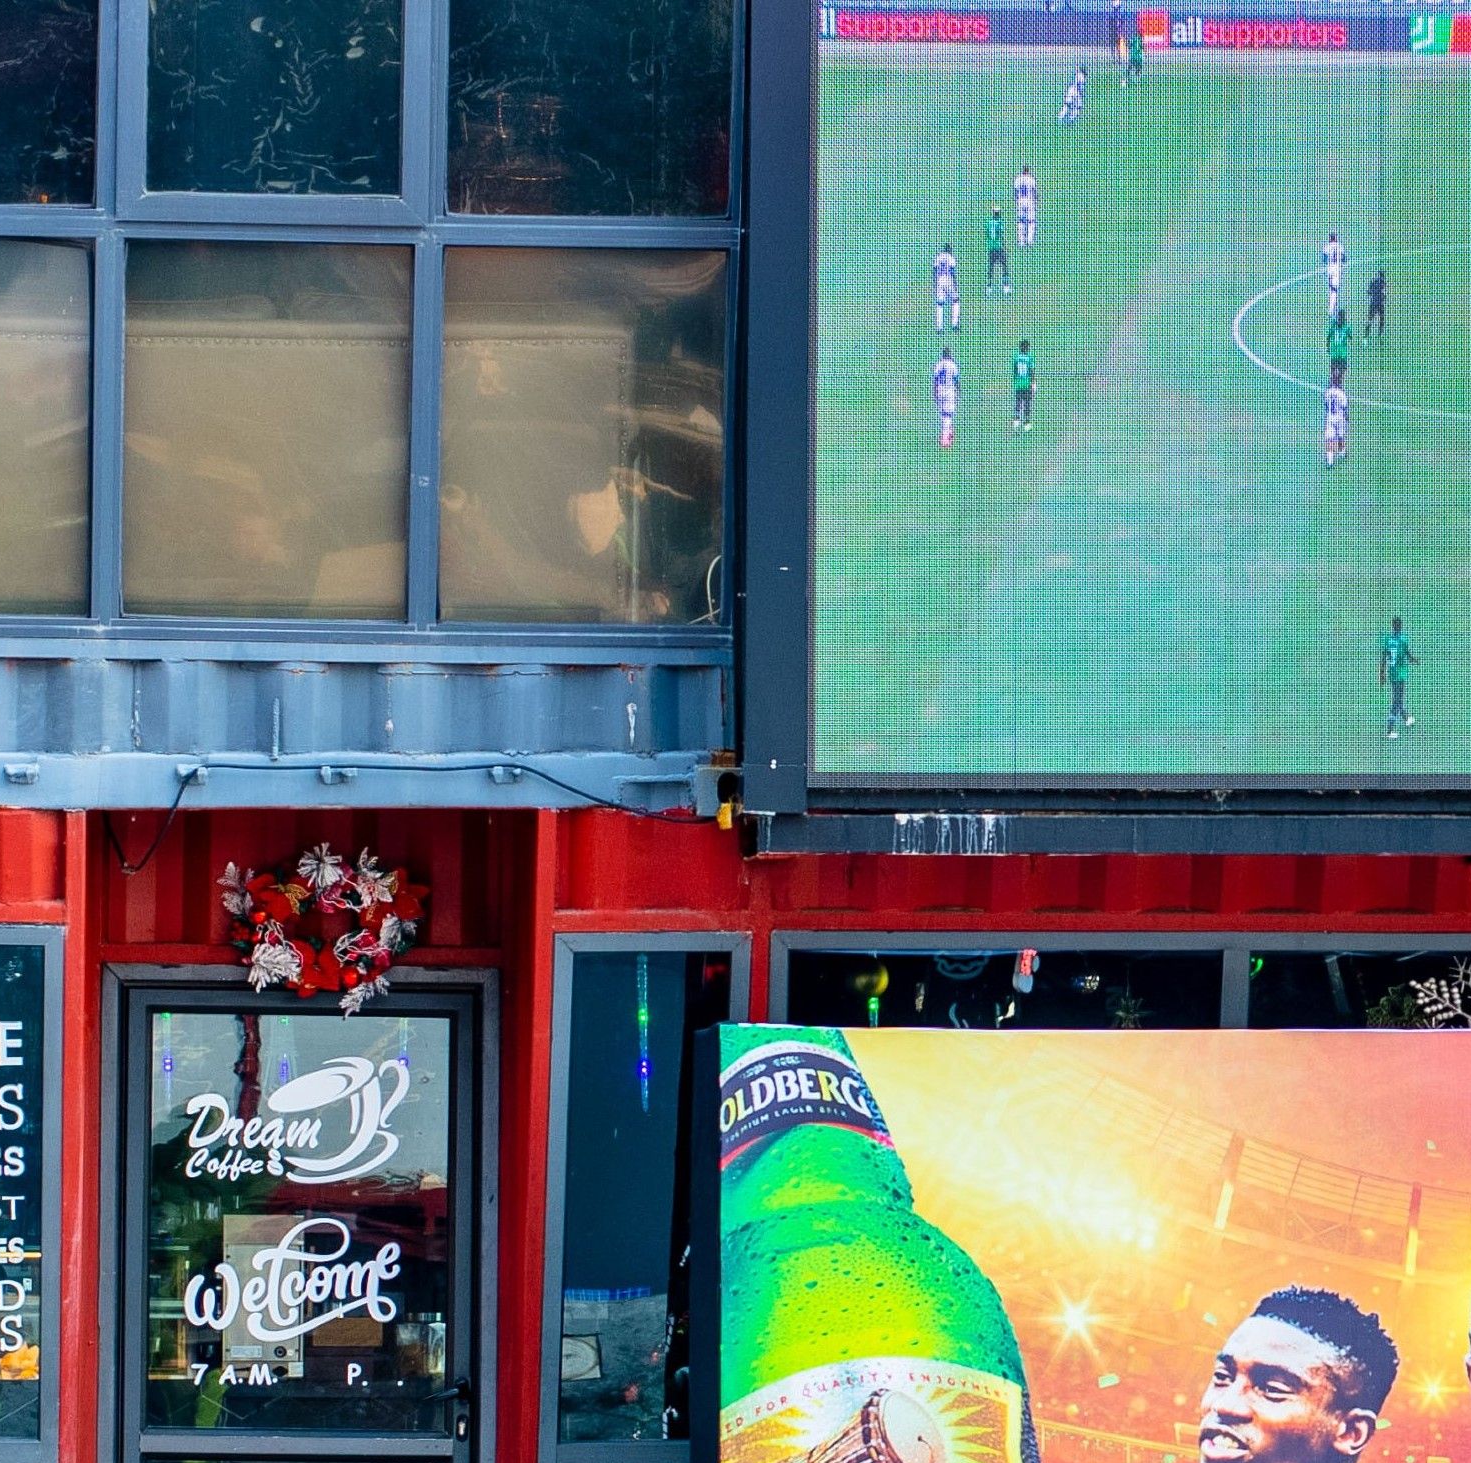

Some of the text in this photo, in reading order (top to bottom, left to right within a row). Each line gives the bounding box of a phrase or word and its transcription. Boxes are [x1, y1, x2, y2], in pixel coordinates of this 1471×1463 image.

[818, 7, 989, 42] llsupporters
[186, 1093, 322, 1150] Dream
[720, 1068, 873, 1133] OLDBERG
[185, 1146, 264, 1181] Coffee
[184, 1217, 401, 1342] Welcome
[191, 1363, 209, 1386] 7
[755, 1395, 788, 1416] FOR
[802, 1373, 893, 1399] QUALITY
[909, 1371, 1009, 1398] ENJOYMEN
